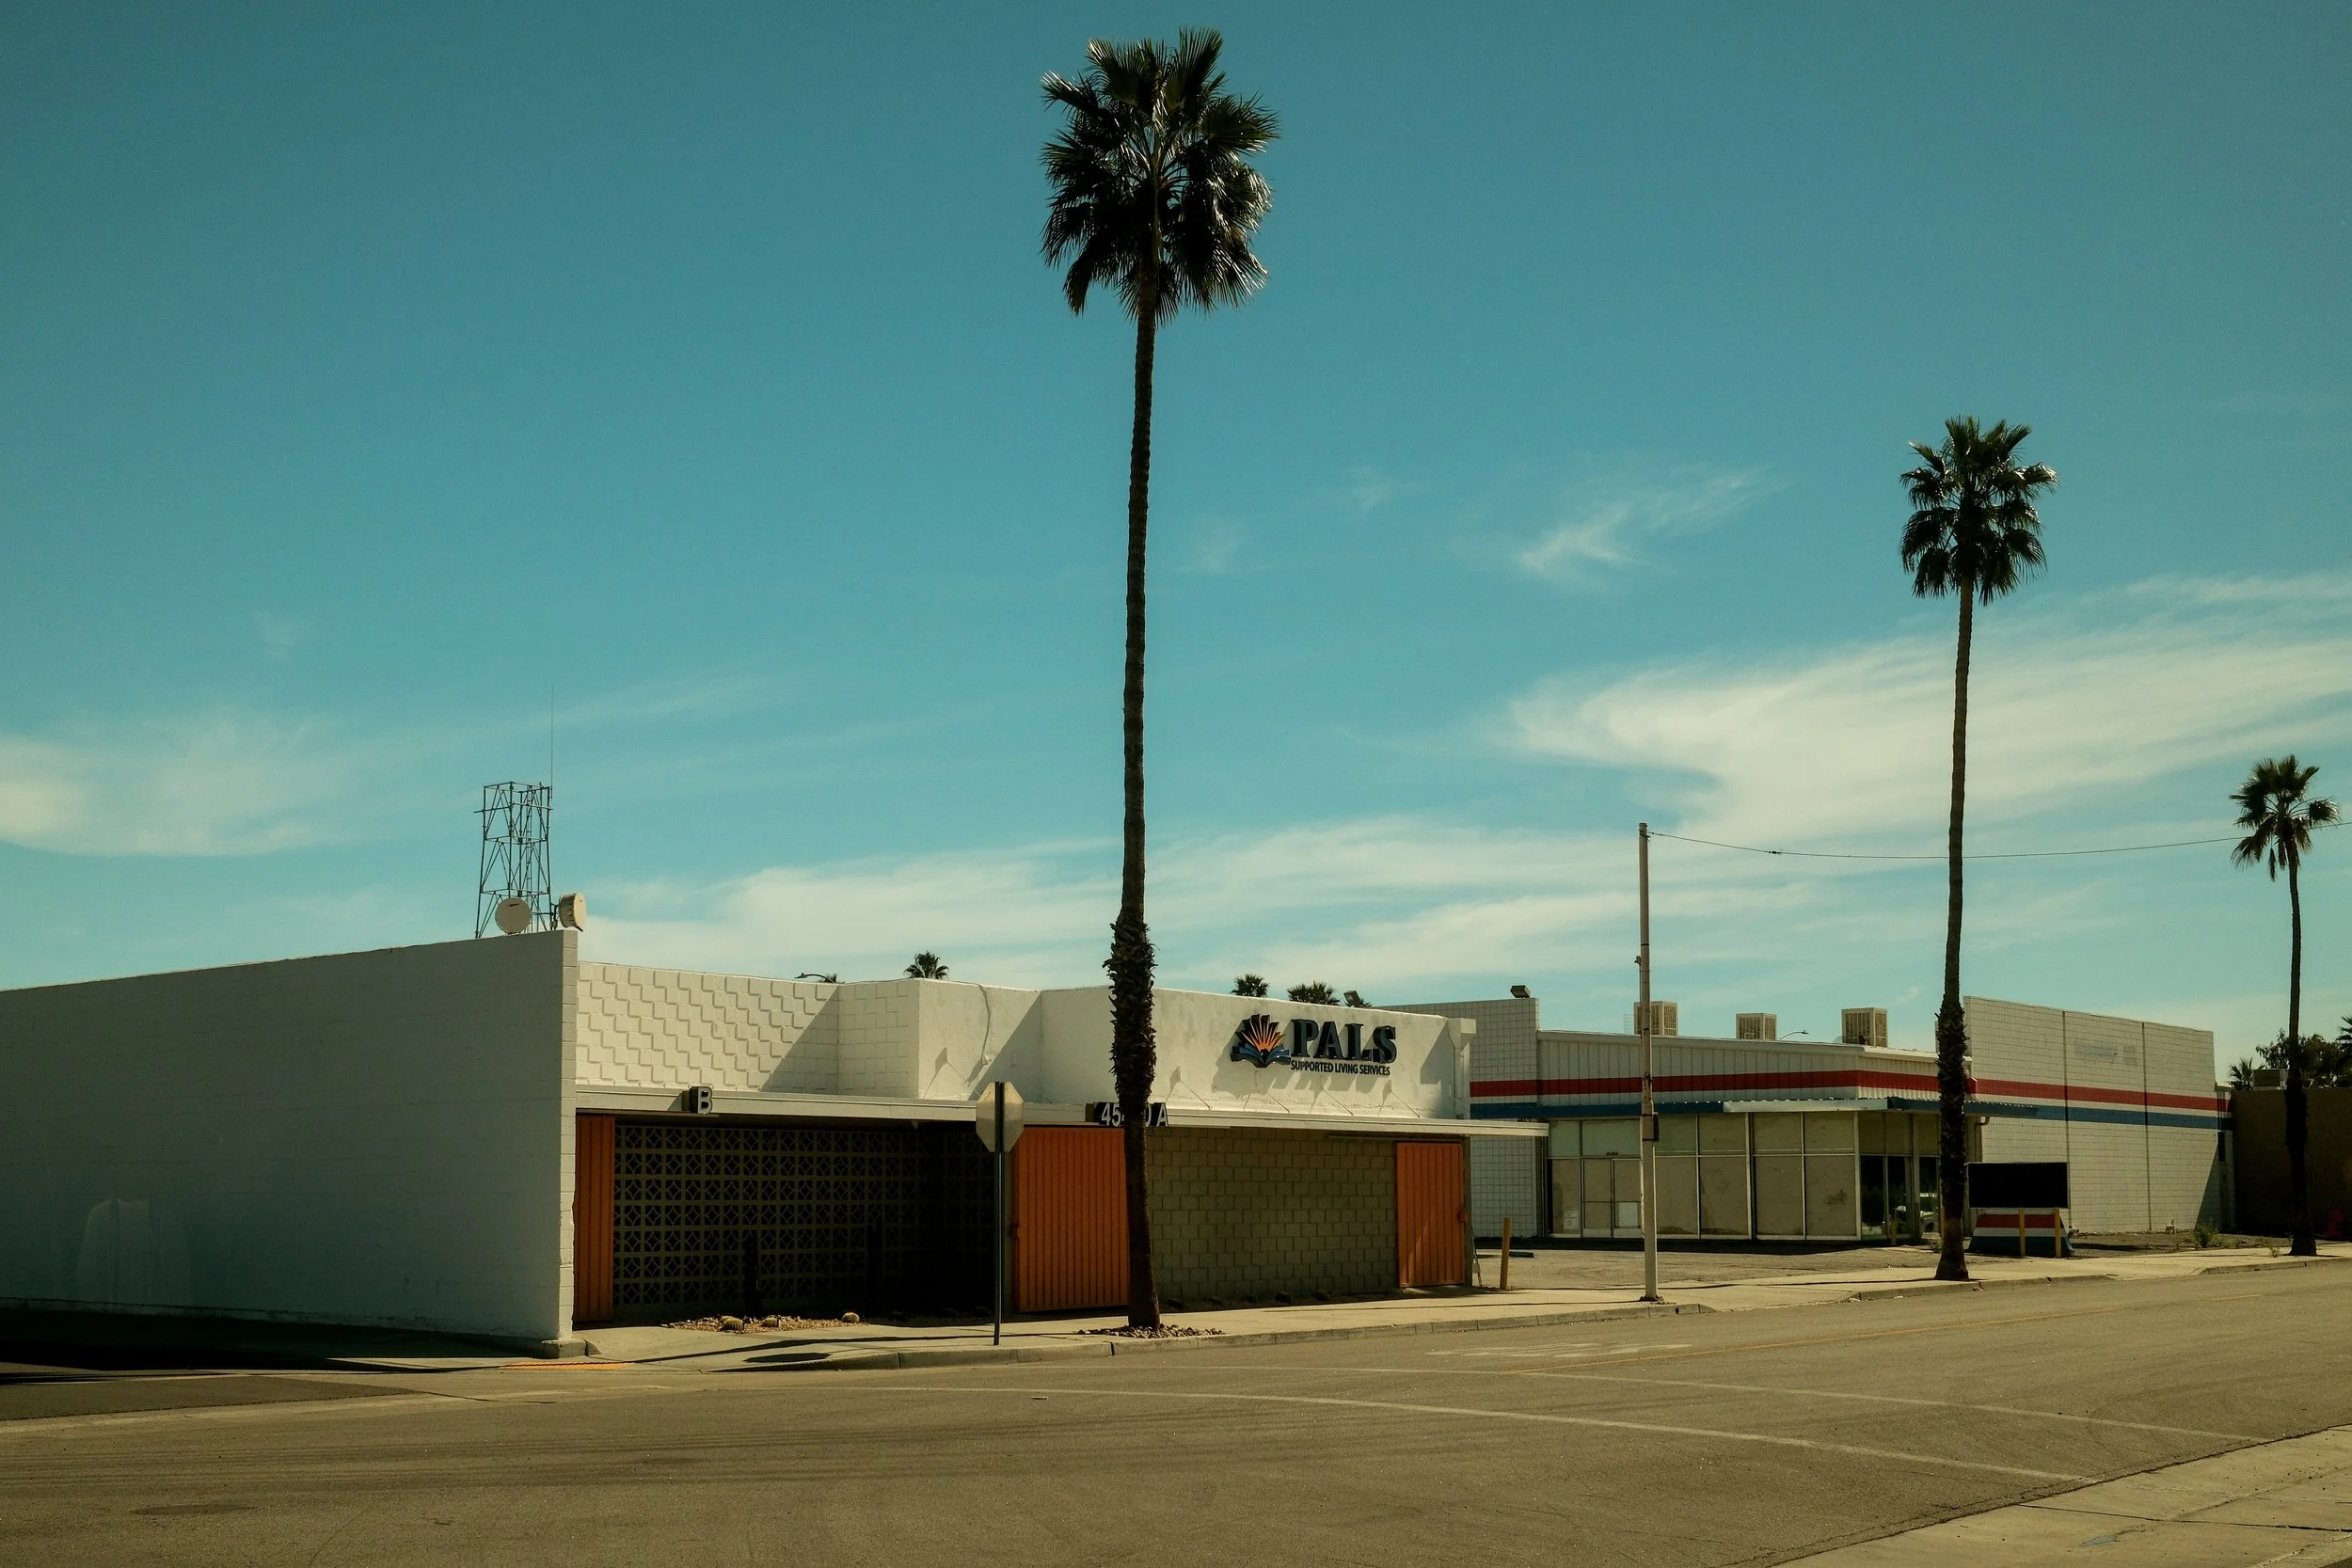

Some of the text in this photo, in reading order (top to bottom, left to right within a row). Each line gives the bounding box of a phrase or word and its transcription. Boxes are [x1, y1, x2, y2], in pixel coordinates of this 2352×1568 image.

[1291, 1019, 1397, 1064] PALS
[1291, 1060, 1391, 1077] SUPPORTED LIVING SERVICES
[696, 1086, 712, 1114] B
[1155, 1102, 1168, 1127] A
